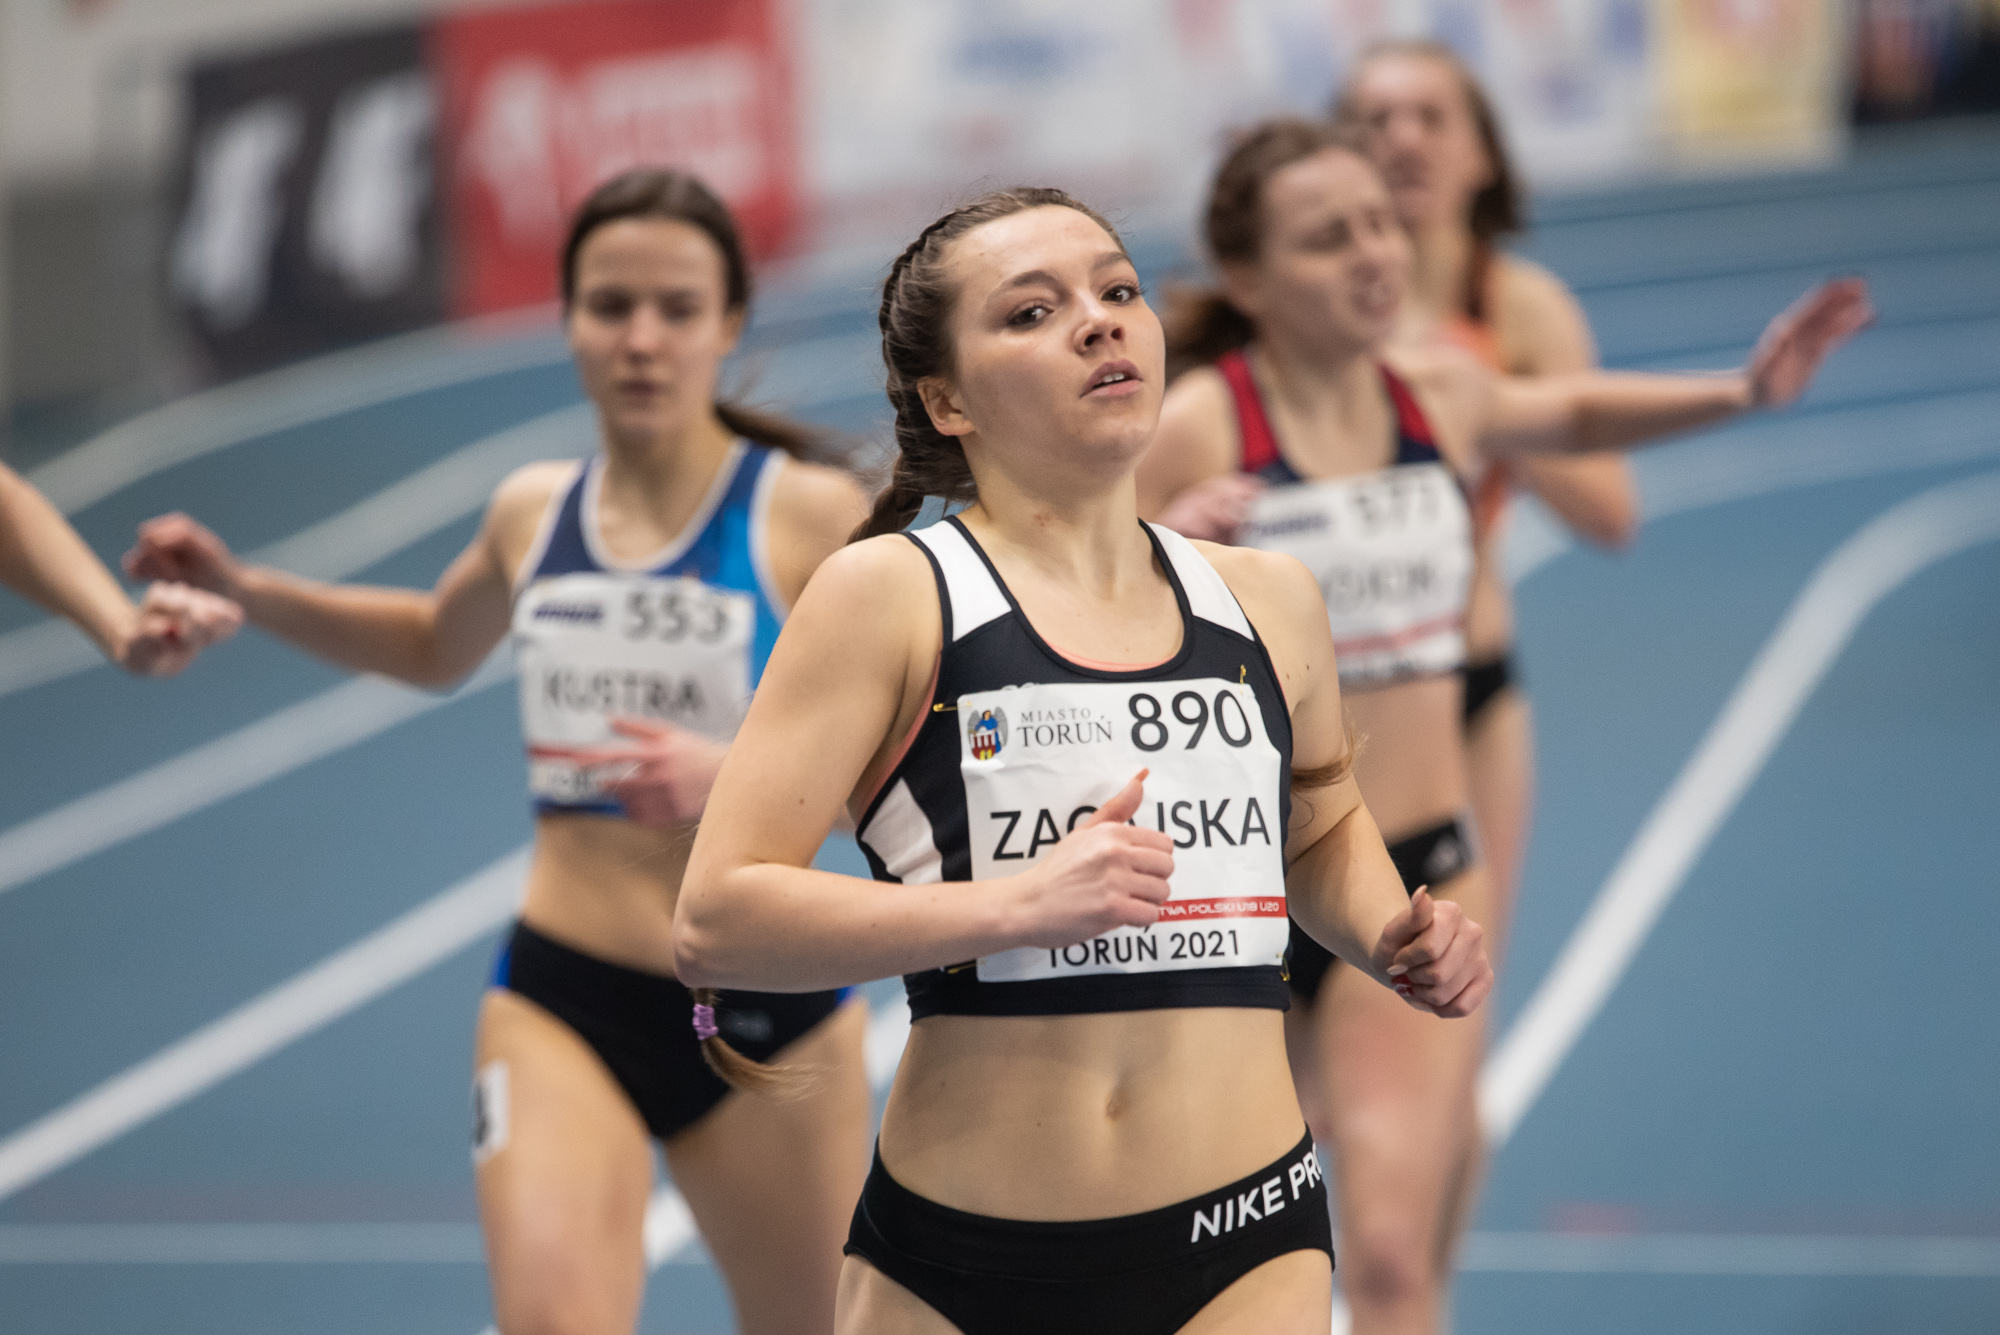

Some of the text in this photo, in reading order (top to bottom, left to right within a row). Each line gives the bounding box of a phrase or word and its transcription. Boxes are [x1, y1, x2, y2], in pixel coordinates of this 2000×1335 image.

[625, 589, 728, 641] 553
[546, 668, 705, 714] KUSTRA
[1016, 714, 1113, 748] TORUŃ
[1020, 707, 1092, 724] MIASTO
[1128, 689, 1252, 752] 890
[990, 797, 1271, 860] ZAJSKA
[1188, 902, 1234, 915] POLSKI
[1259, 901, 1280, 912] U20
[1170, 930, 1239, 960] 2021
[1191, 1176, 1285, 1243] NIKE
